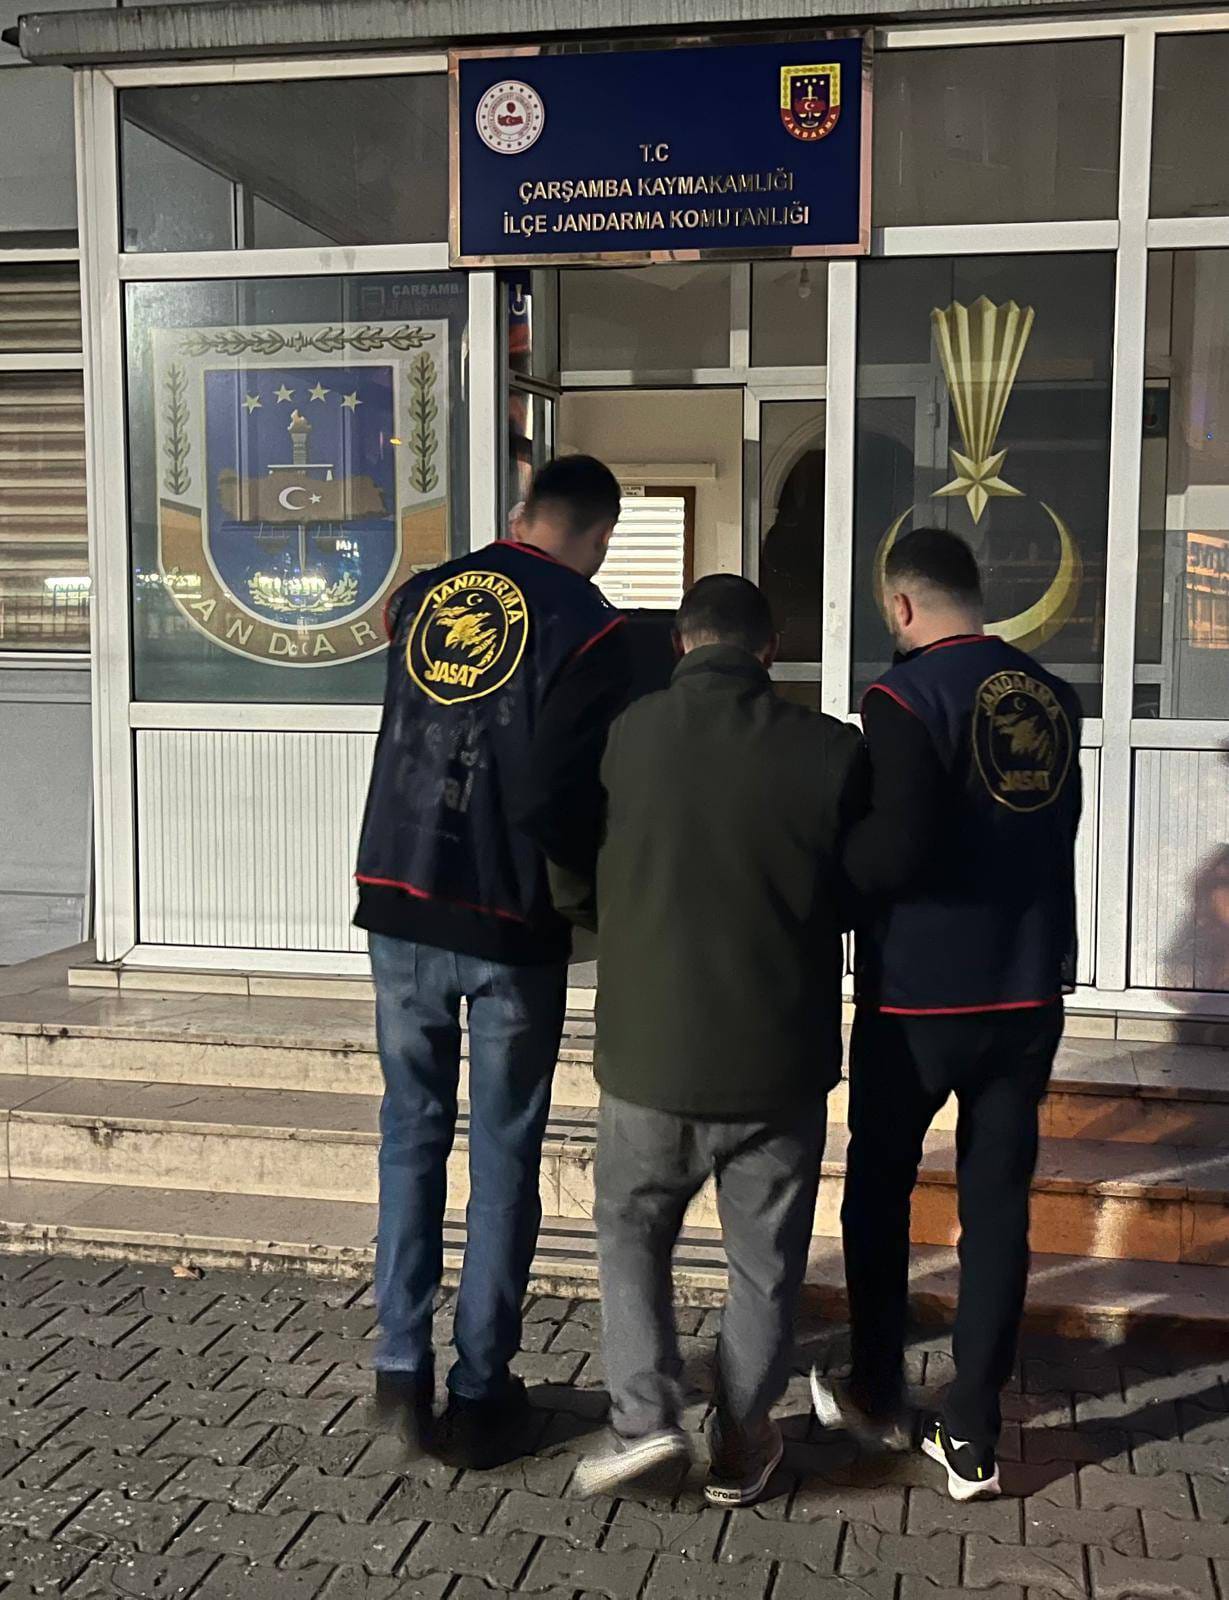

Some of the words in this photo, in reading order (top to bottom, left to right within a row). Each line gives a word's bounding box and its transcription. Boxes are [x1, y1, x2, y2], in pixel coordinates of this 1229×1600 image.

[784, 114, 837, 138] JANDARMA
[639, 143, 669, 163] T.C
[518, 178, 633, 205] ÇARŞAMBA
[637, 166, 794, 196] KAYMAKAMLIĞI
[503, 211, 547, 238] İLÇE
[552, 211, 665, 233] JANDARMA
[669, 200, 809, 229] KOMUTANLIĞI
[432, 575, 524, 625] JANDARMA
[424, 660, 484, 688] JASAT
